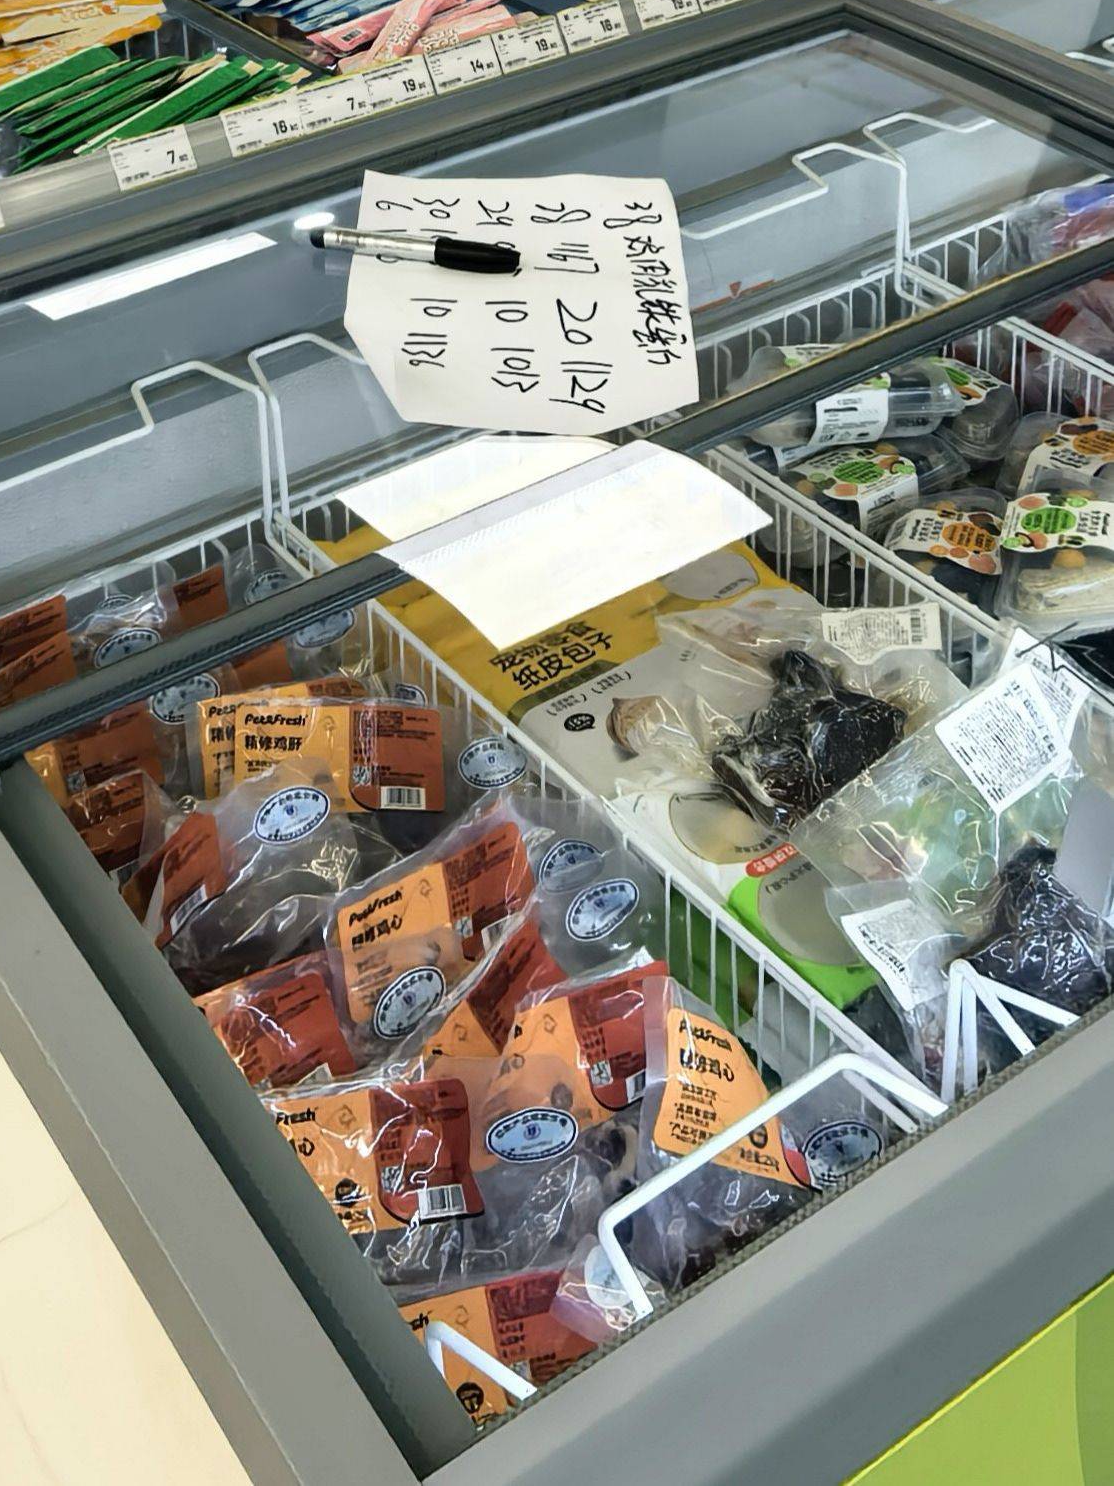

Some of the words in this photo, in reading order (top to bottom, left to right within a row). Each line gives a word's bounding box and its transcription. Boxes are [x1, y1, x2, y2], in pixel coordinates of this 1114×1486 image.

[346, 96, 355, 111] 7
[166, 149, 176, 165] 7
[412, 197, 461, 220] 30
[603, 201, 663, 230] 38
[409, 297, 458, 318] 10
[486, 300, 529, 323] 10
[555, 297, 599, 345] 20
[512, 631, 613, 691] 纸皮包子
